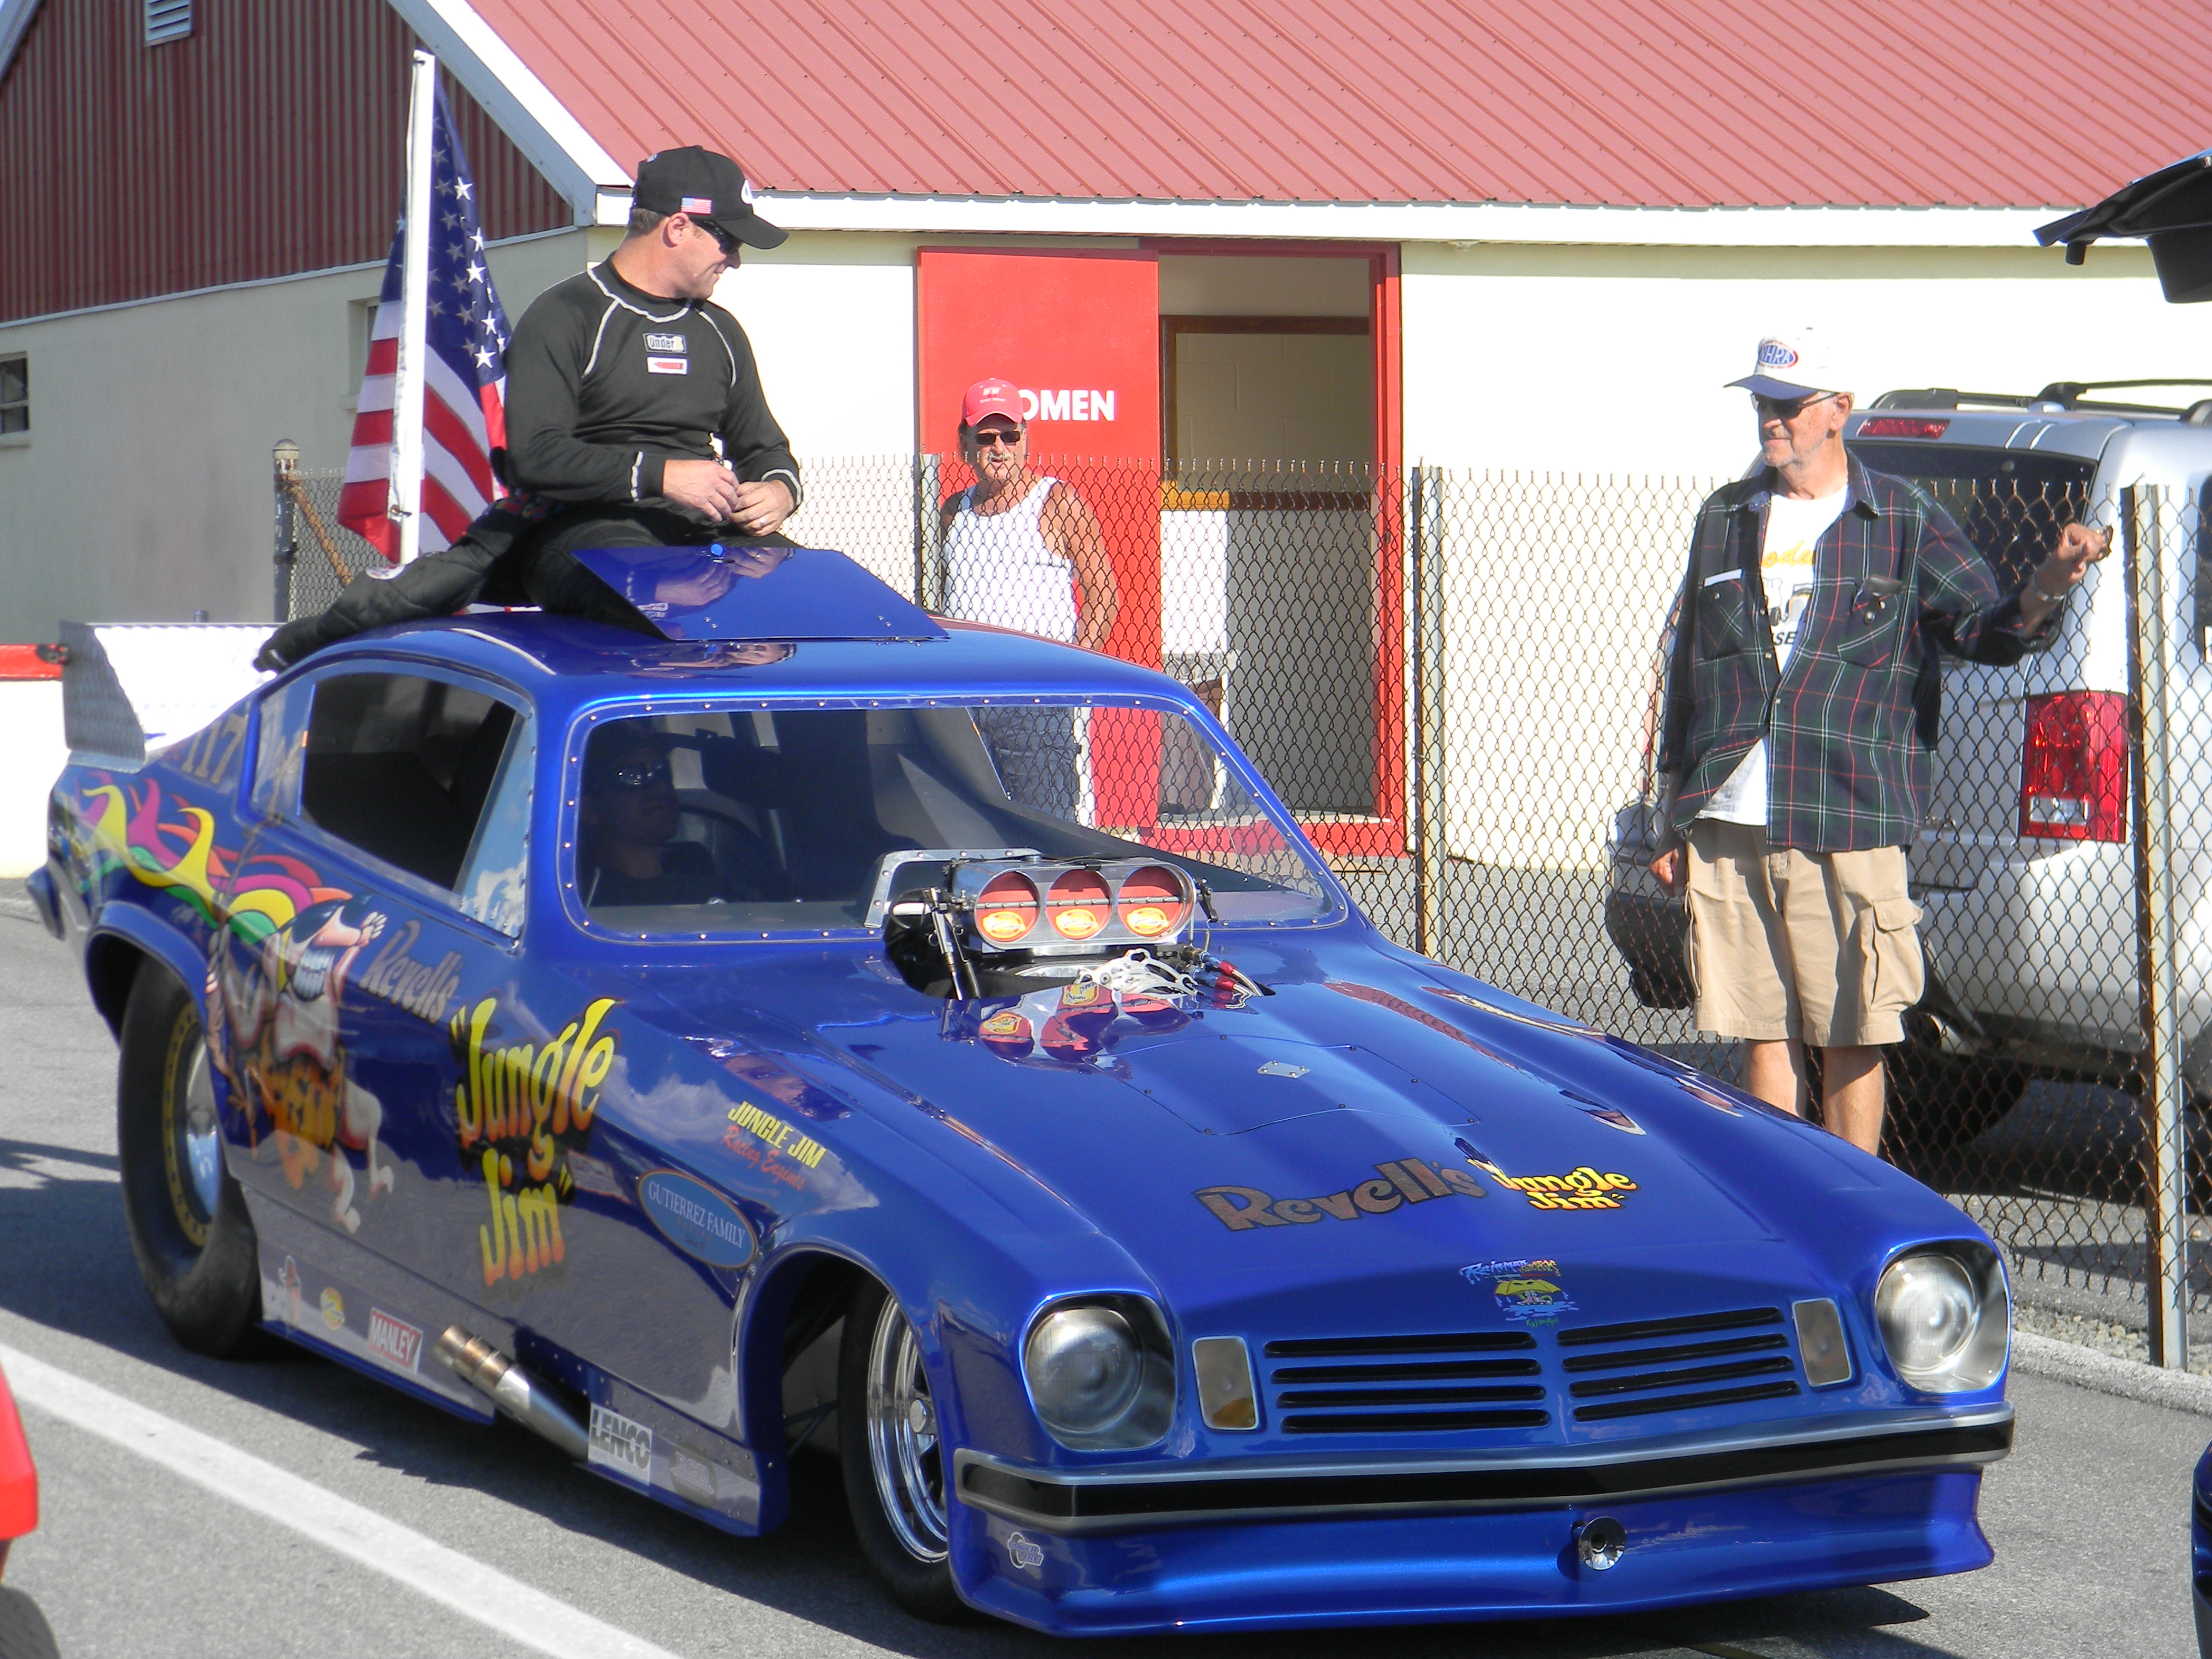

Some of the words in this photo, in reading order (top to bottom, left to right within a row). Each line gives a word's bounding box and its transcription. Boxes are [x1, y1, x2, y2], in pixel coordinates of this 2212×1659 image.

[1018, 389, 1114, 421] OMEN
[1772, 632, 1798, 646] SE
[182, 713, 248, 785] 117
[359, 920, 465, 1024] Revell's
[721, 1125, 761, 1170] Racing
[760, 1149, 806, 1191] Engines
[727, 1101, 794, 1149] JUNGLE
[787, 1136, 827, 1169] JIM
[648, 1181, 706, 1227] GUTIERREZ
[706, 1212, 746, 1248] FAMILY
[1193, 1158, 1486, 1230] Revell's
[369, 1314, 415, 1362] MANLEY
[589, 1408, 650, 1469] LENCO
